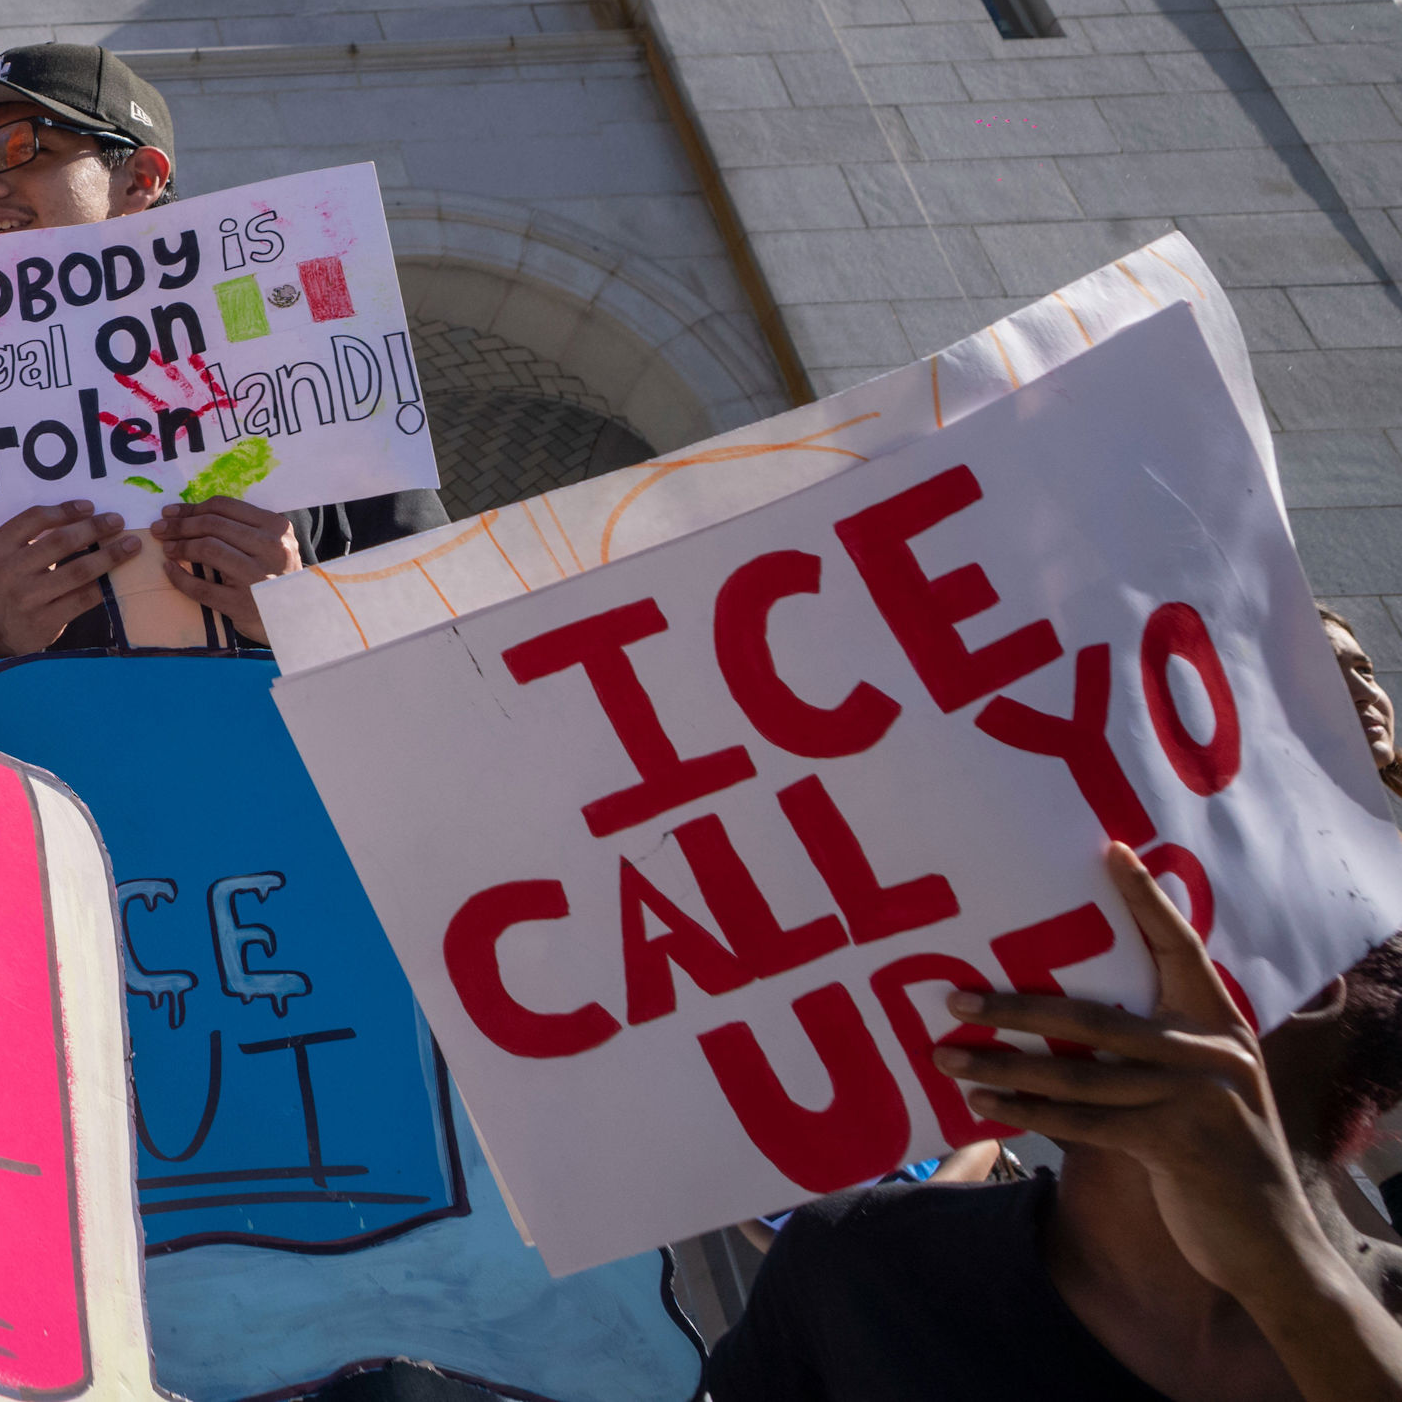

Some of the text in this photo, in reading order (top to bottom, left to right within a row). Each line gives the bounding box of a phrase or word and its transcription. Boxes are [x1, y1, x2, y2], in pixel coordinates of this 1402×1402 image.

[95, 301, 208, 376] on
[501, 462, 1065, 838] ICE
[442, 601, 1242, 1060] CALL YO
[117, 870, 313, 1030] CE
[130, 1028, 356, 1188] UT
